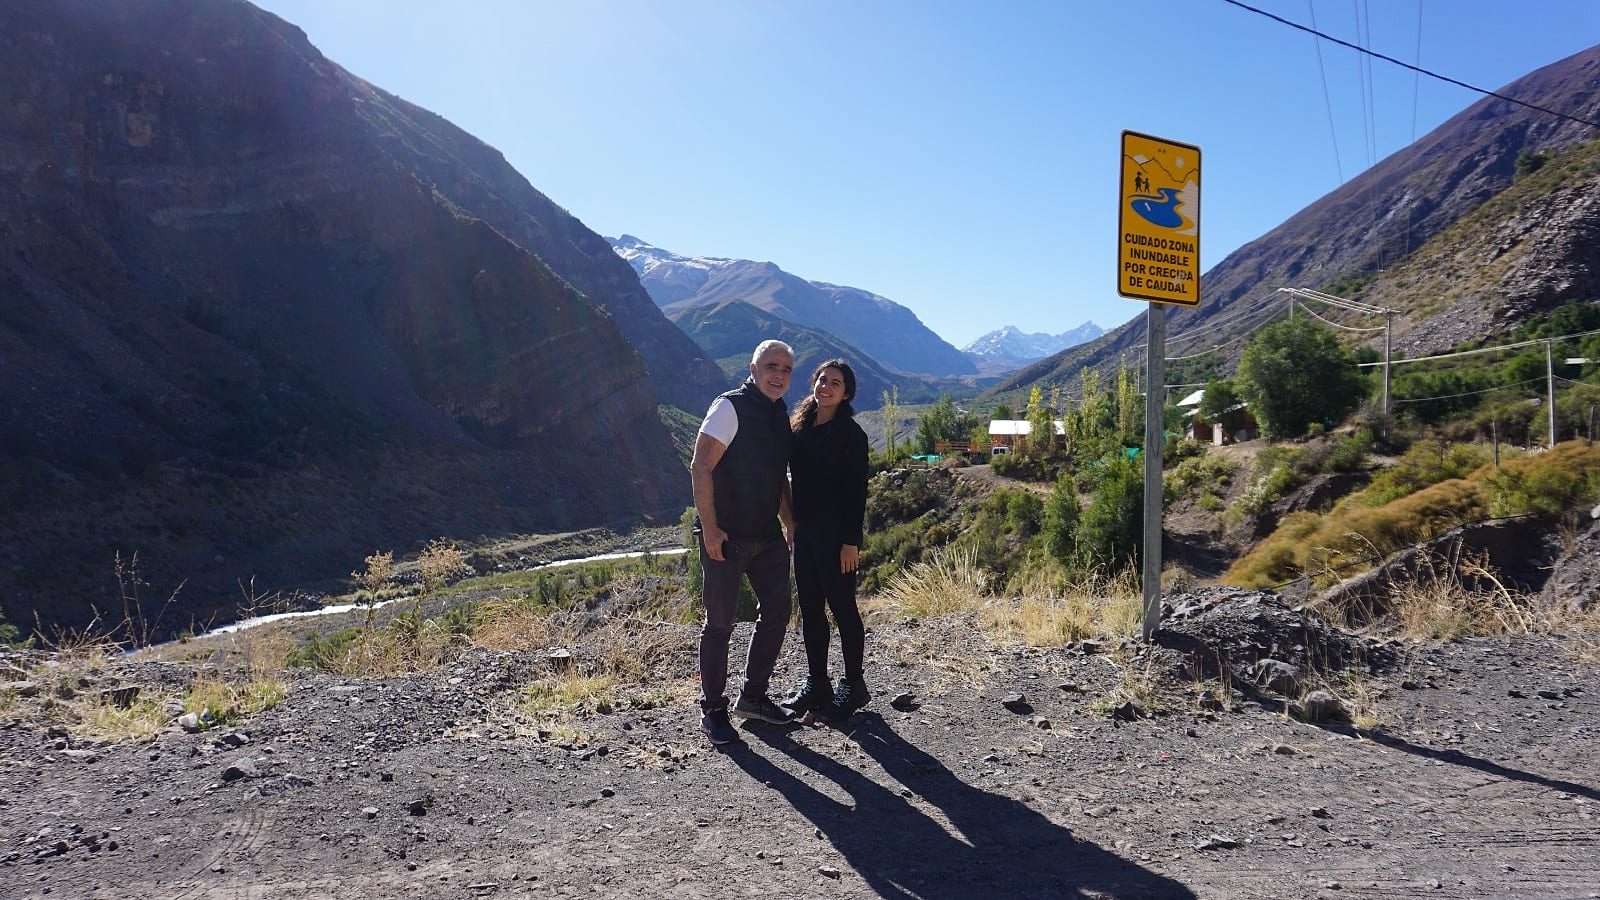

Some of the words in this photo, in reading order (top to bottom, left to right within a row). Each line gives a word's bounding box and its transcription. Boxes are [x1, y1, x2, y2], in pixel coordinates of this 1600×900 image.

[1125, 233, 1167, 249] CUIDADO
[1169, 240, 1195, 253] ZONA
[1130, 248, 1189, 266] INUNDABLE
[1125, 262, 1146, 274] POR
[1148, 266, 1194, 281] CRECIDA
[1129, 276, 1143, 287] DE
[1146, 279, 1188, 293] CAUDAL
